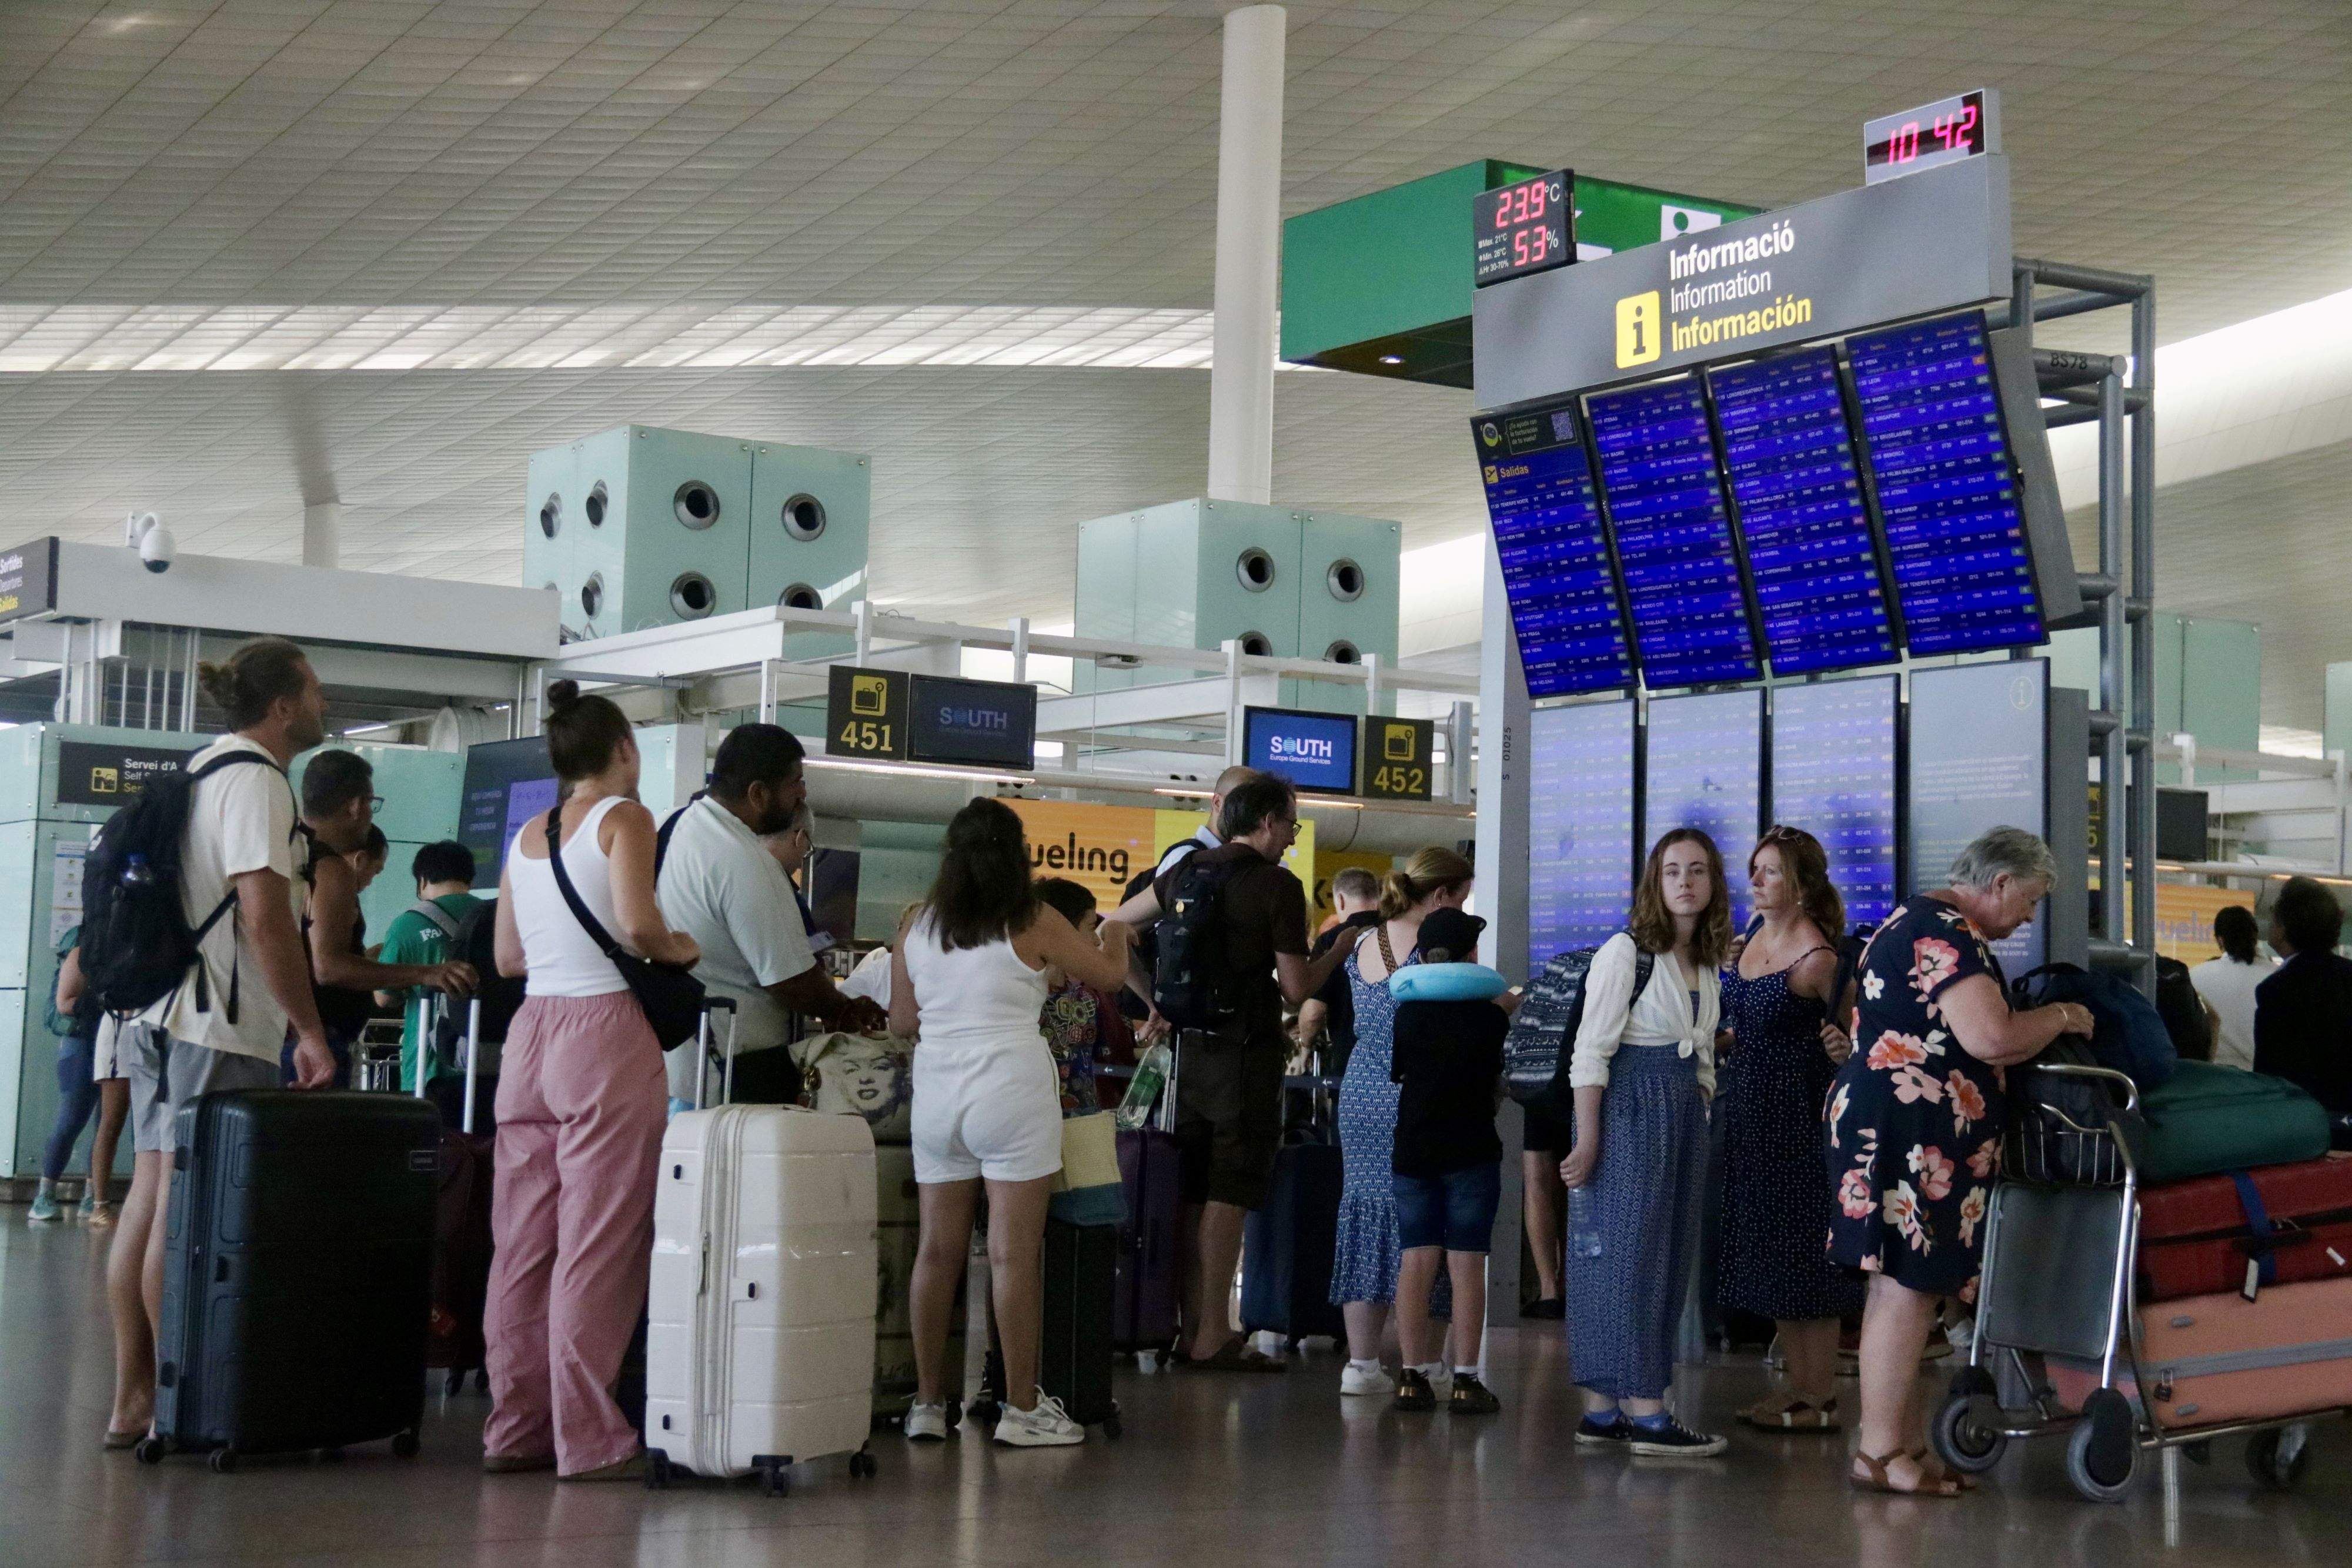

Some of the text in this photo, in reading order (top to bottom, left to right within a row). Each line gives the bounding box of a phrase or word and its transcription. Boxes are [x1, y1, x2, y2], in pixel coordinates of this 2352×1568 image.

[1888, 105, 1977, 165] 10 42
[1515, 225, 1558, 266] 53 %
[1671, 219, 1795, 280] Informació
[1671, 270, 1771, 313] Information
[1672, 294, 1812, 352] Información
[1500, 464, 1529, 478] Salidas
[1902, 466, 1926, 474] MALLORCA
[1762, 494, 1785, 502] MALLORCA
[840, 721, 893, 751] 451
[125, 758, 158, 770] Servei
[125, 771, 141, 781] Self
[1374, 766, 1424, 793] 452
